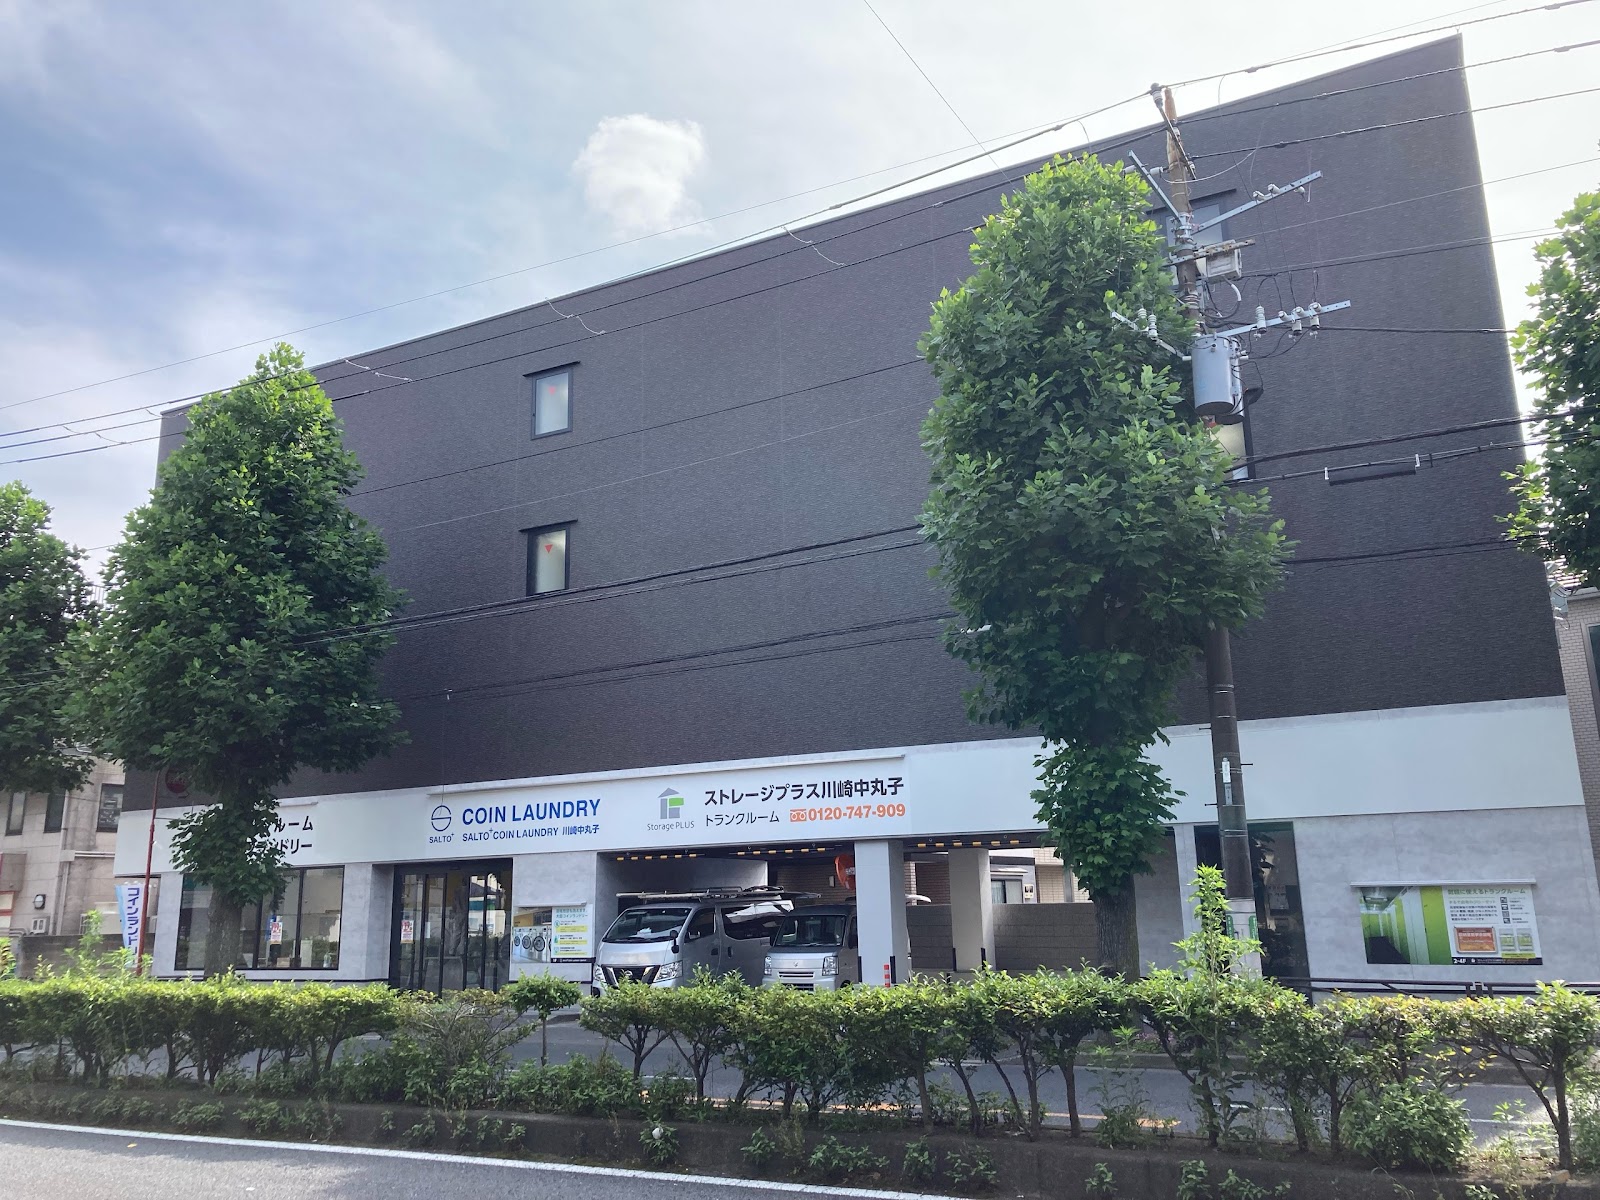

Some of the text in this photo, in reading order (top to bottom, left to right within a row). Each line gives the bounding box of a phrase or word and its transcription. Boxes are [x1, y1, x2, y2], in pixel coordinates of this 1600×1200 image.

[705, 777, 904, 807] ストレージプラス川崎中丸子
[462, 799, 601, 825] COIN LAUNDRY
[706, 811, 780, 826] トランクルーム
[808, 803, 906, 821] 0120-747-909
[562, 824, 600, 836] 川崎中丸子
[647, 820, 695, 832] Storage PLUS
